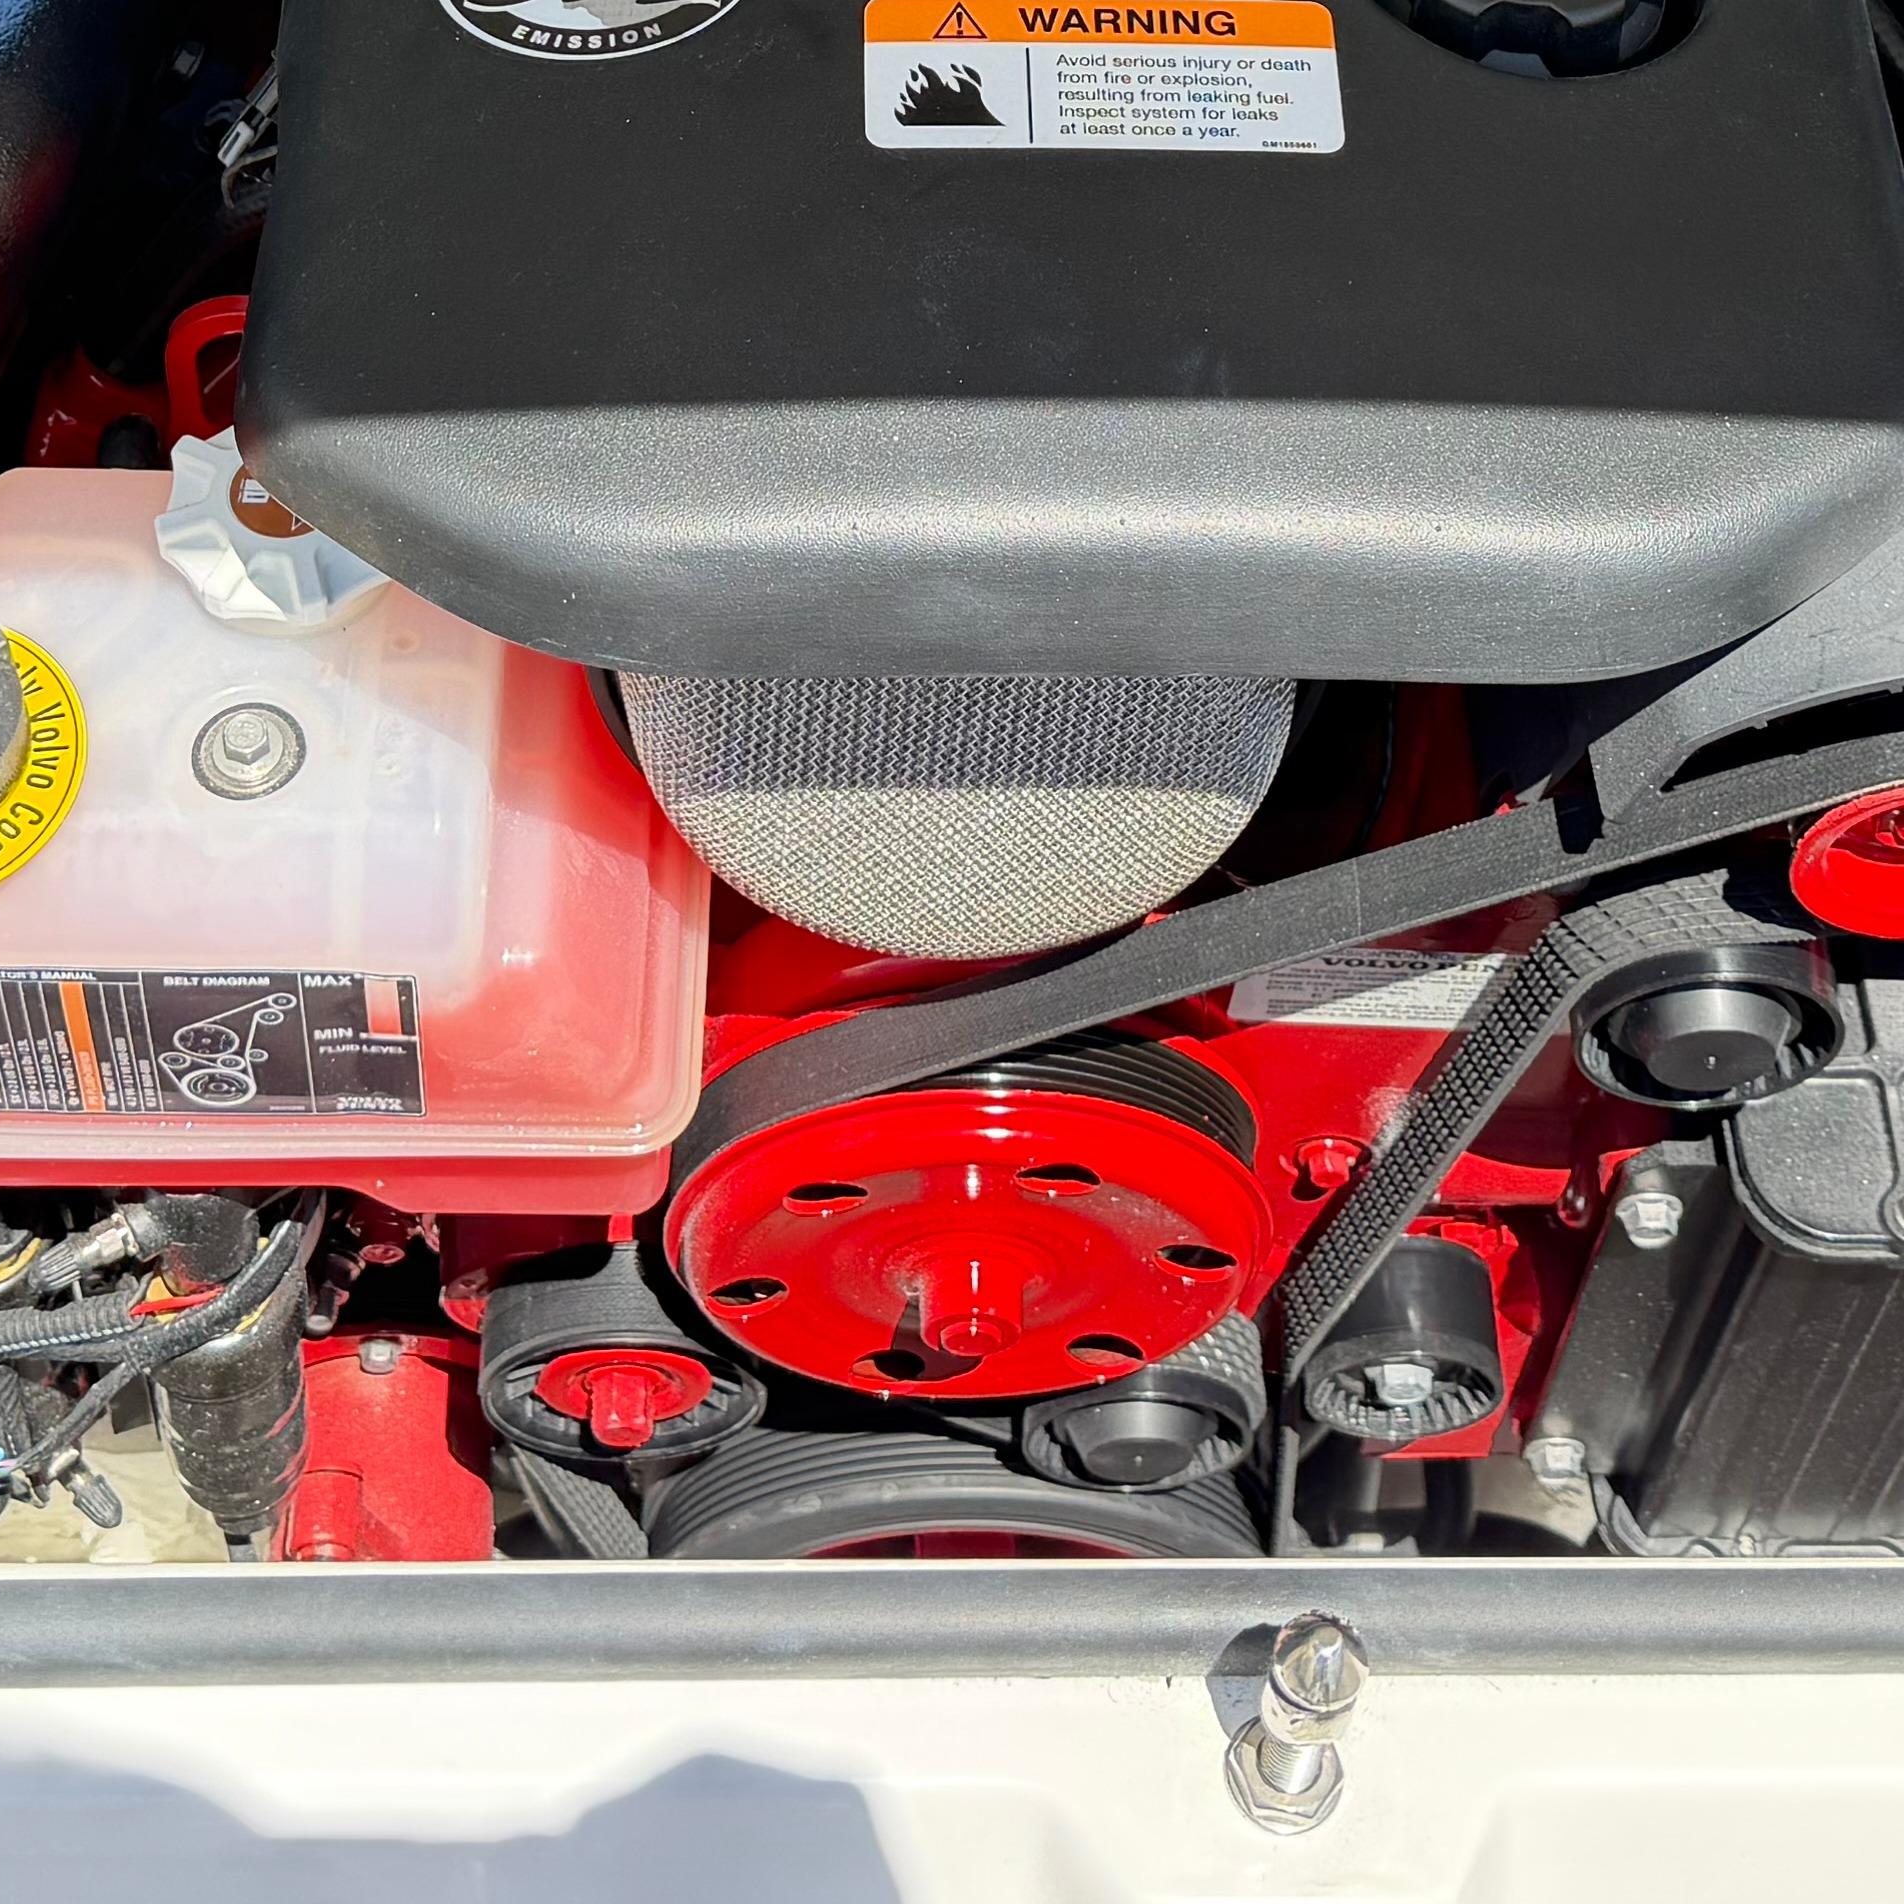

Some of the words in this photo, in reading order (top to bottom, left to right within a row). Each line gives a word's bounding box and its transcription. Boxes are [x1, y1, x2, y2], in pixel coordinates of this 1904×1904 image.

[1018, 7, 1237, 36] WARNING
[512, 23, 662, 49] EMISSION
[1056, 54, 1106, 67] Avoid
[1112, 56, 1176, 68] serious
[1183, 56, 1231, 71] injury
[1237, 59, 1256, 70] or
[1261, 58, 1311, 72] death
[1057, 71, 1097, 84] from
[1104, 72, 1131, 84] fire
[1137, 75, 1154, 85] or
[1161, 73, 1253, 88] explosion,
[1058, 89, 1134, 104] resulting
[1141, 90, 1181, 102] from
[1187, 90, 1250, 106] leaking
[1257, 92, 1294, 104] fuel.
[1059, 106, 1125, 120] Inspect
[1132, 108, 1196, 121] system
[1202, 107, 1225, 119] for
[1232, 108, 1279, 121] leaks
[1060, 123, 1076, 135] at
[1083, 123, 1125, 136] least
[1132, 125, 1176, 136] once
[1182, 127, 1192, 136] a
[1198, 125, 1240, 139] year.
[31, 701, 70, 790] Volvo
[1322, 955, 1433, 970] VOLVO
[40, 970, 96, 980] MANUAL
[163, 976, 200, 986] BELT
[202, 976, 270, 987] DIAGRAM
[304, 974, 352, 987] MAX
[314, 1027, 353, 1041] MIN
[319, 1045, 360, 1054] FLUID
[362, 1045, 407, 1054] LEVEL
